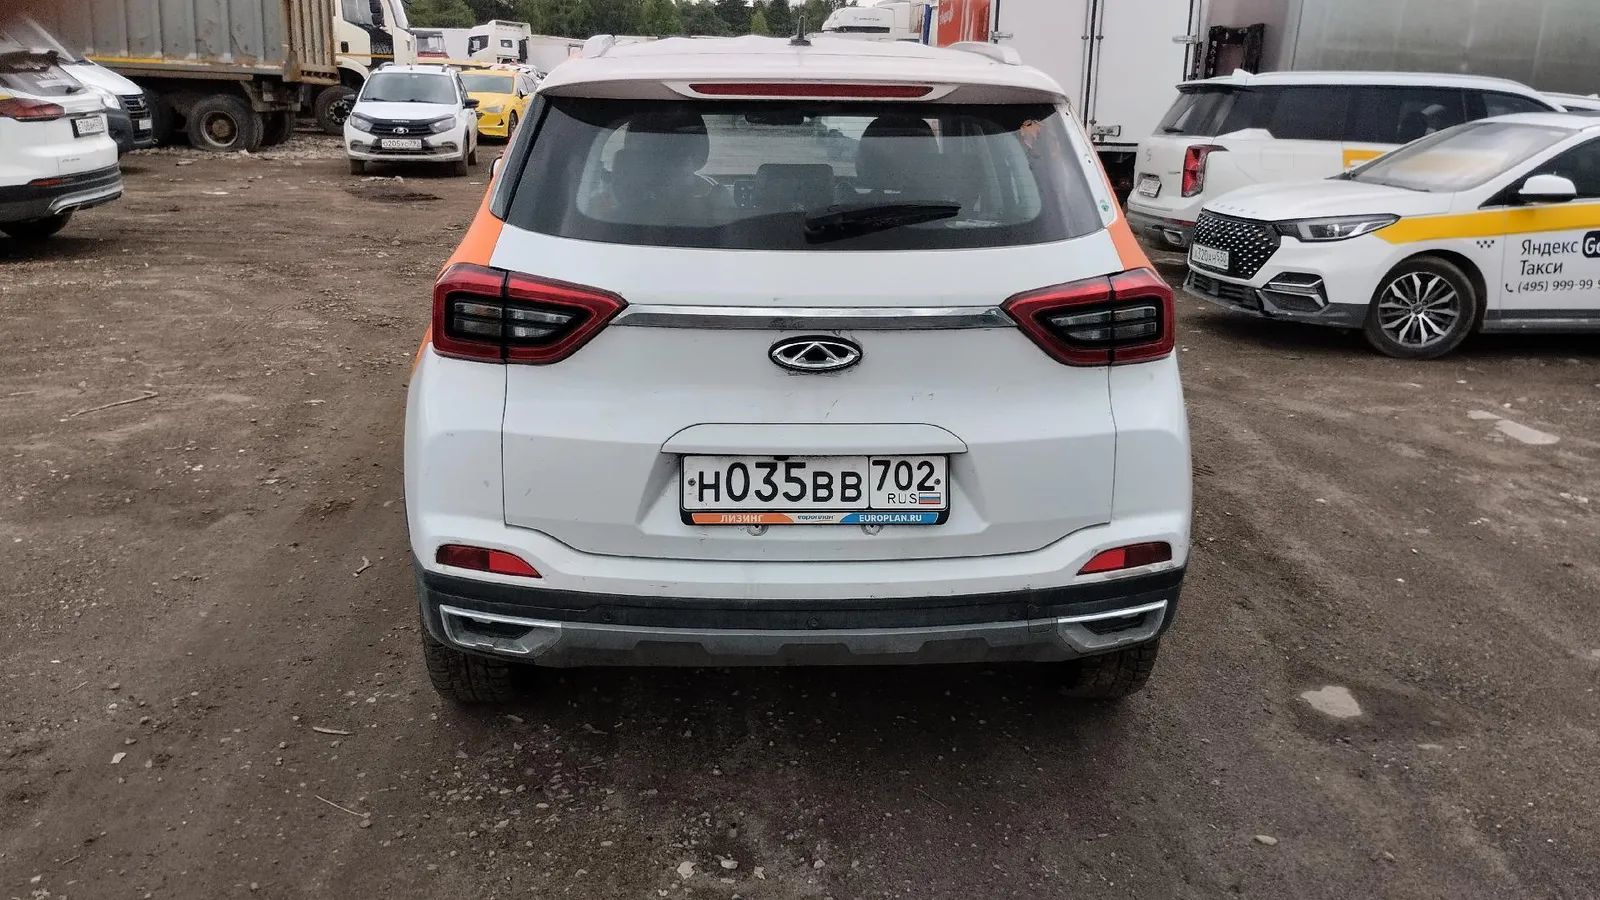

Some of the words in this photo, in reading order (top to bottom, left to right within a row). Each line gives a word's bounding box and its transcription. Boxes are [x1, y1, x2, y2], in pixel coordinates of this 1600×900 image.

[1521, 239, 1579, 257] Яндекс
[1520, 259, 1564, 276] Такси
[1518, 280, 1549, 293] (495)
[1552, 279, 1593, 291] 999-99
[698, 462, 862, 503] Н035ВВ
[872, 460, 936, 491] 702
[887, 493, 918, 505] RUS
[720, 513, 764, 524] ЛИЗИНГ
[859, 514, 922, 523] EUROPLAN.RU
